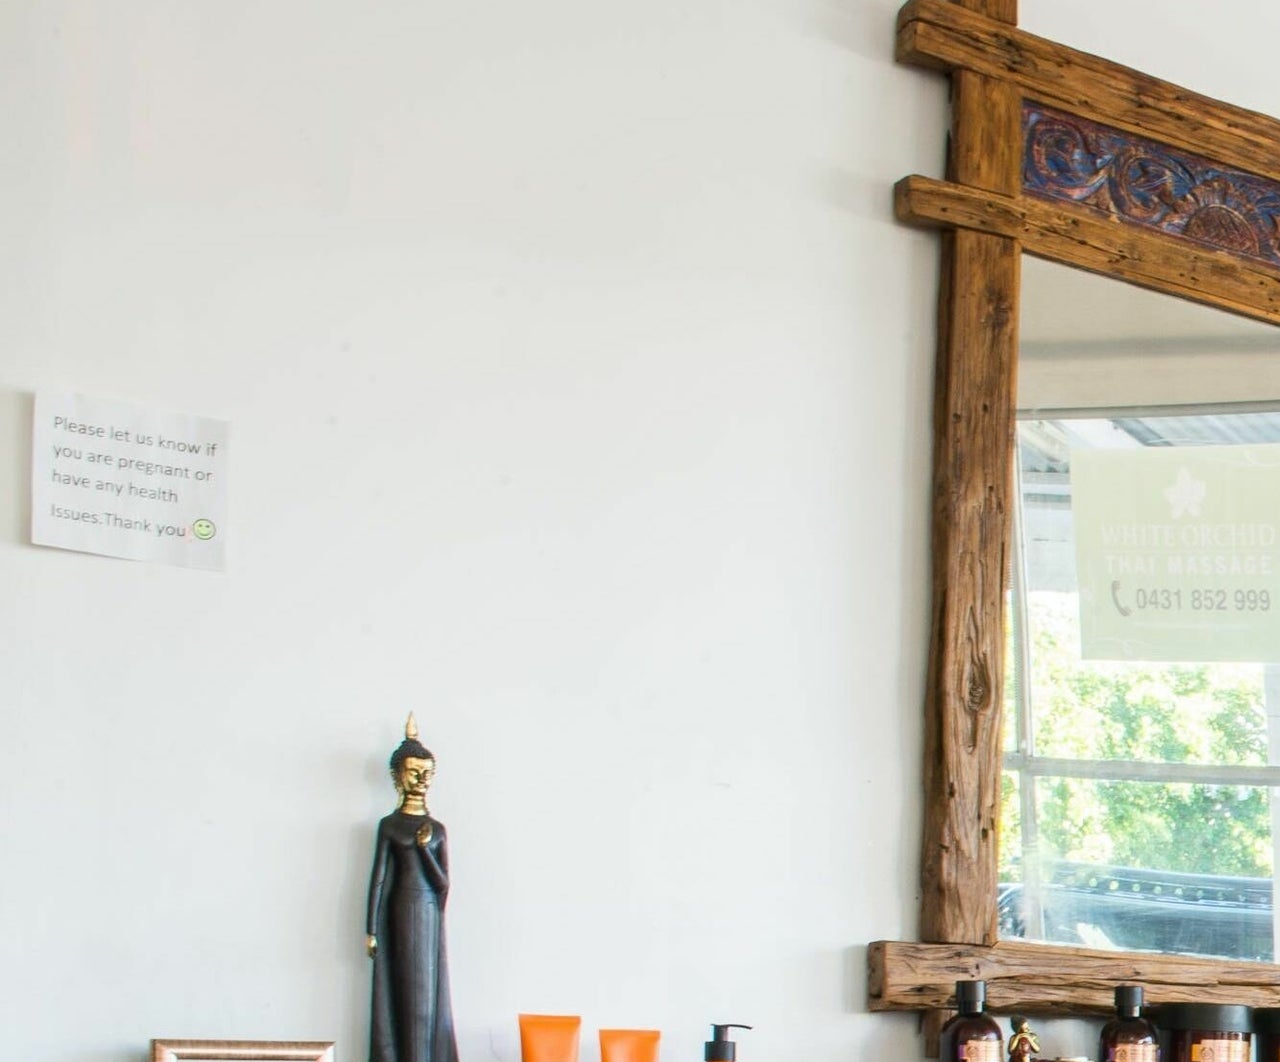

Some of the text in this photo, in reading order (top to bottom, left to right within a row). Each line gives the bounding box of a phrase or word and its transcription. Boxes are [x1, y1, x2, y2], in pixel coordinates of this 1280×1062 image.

[53, 415, 218, 456] Please let us know if
[53, 444, 213, 482] you are pregnant or
[51, 468, 179, 503] have any health
[156, 523, 186, 538] you
[1101, 522, 1275, 547] WHITE ORCHID
[1105, 554, 1272, 576] THAI MASSAGE
[1135, 588, 1271, 612] 0431 852 999
